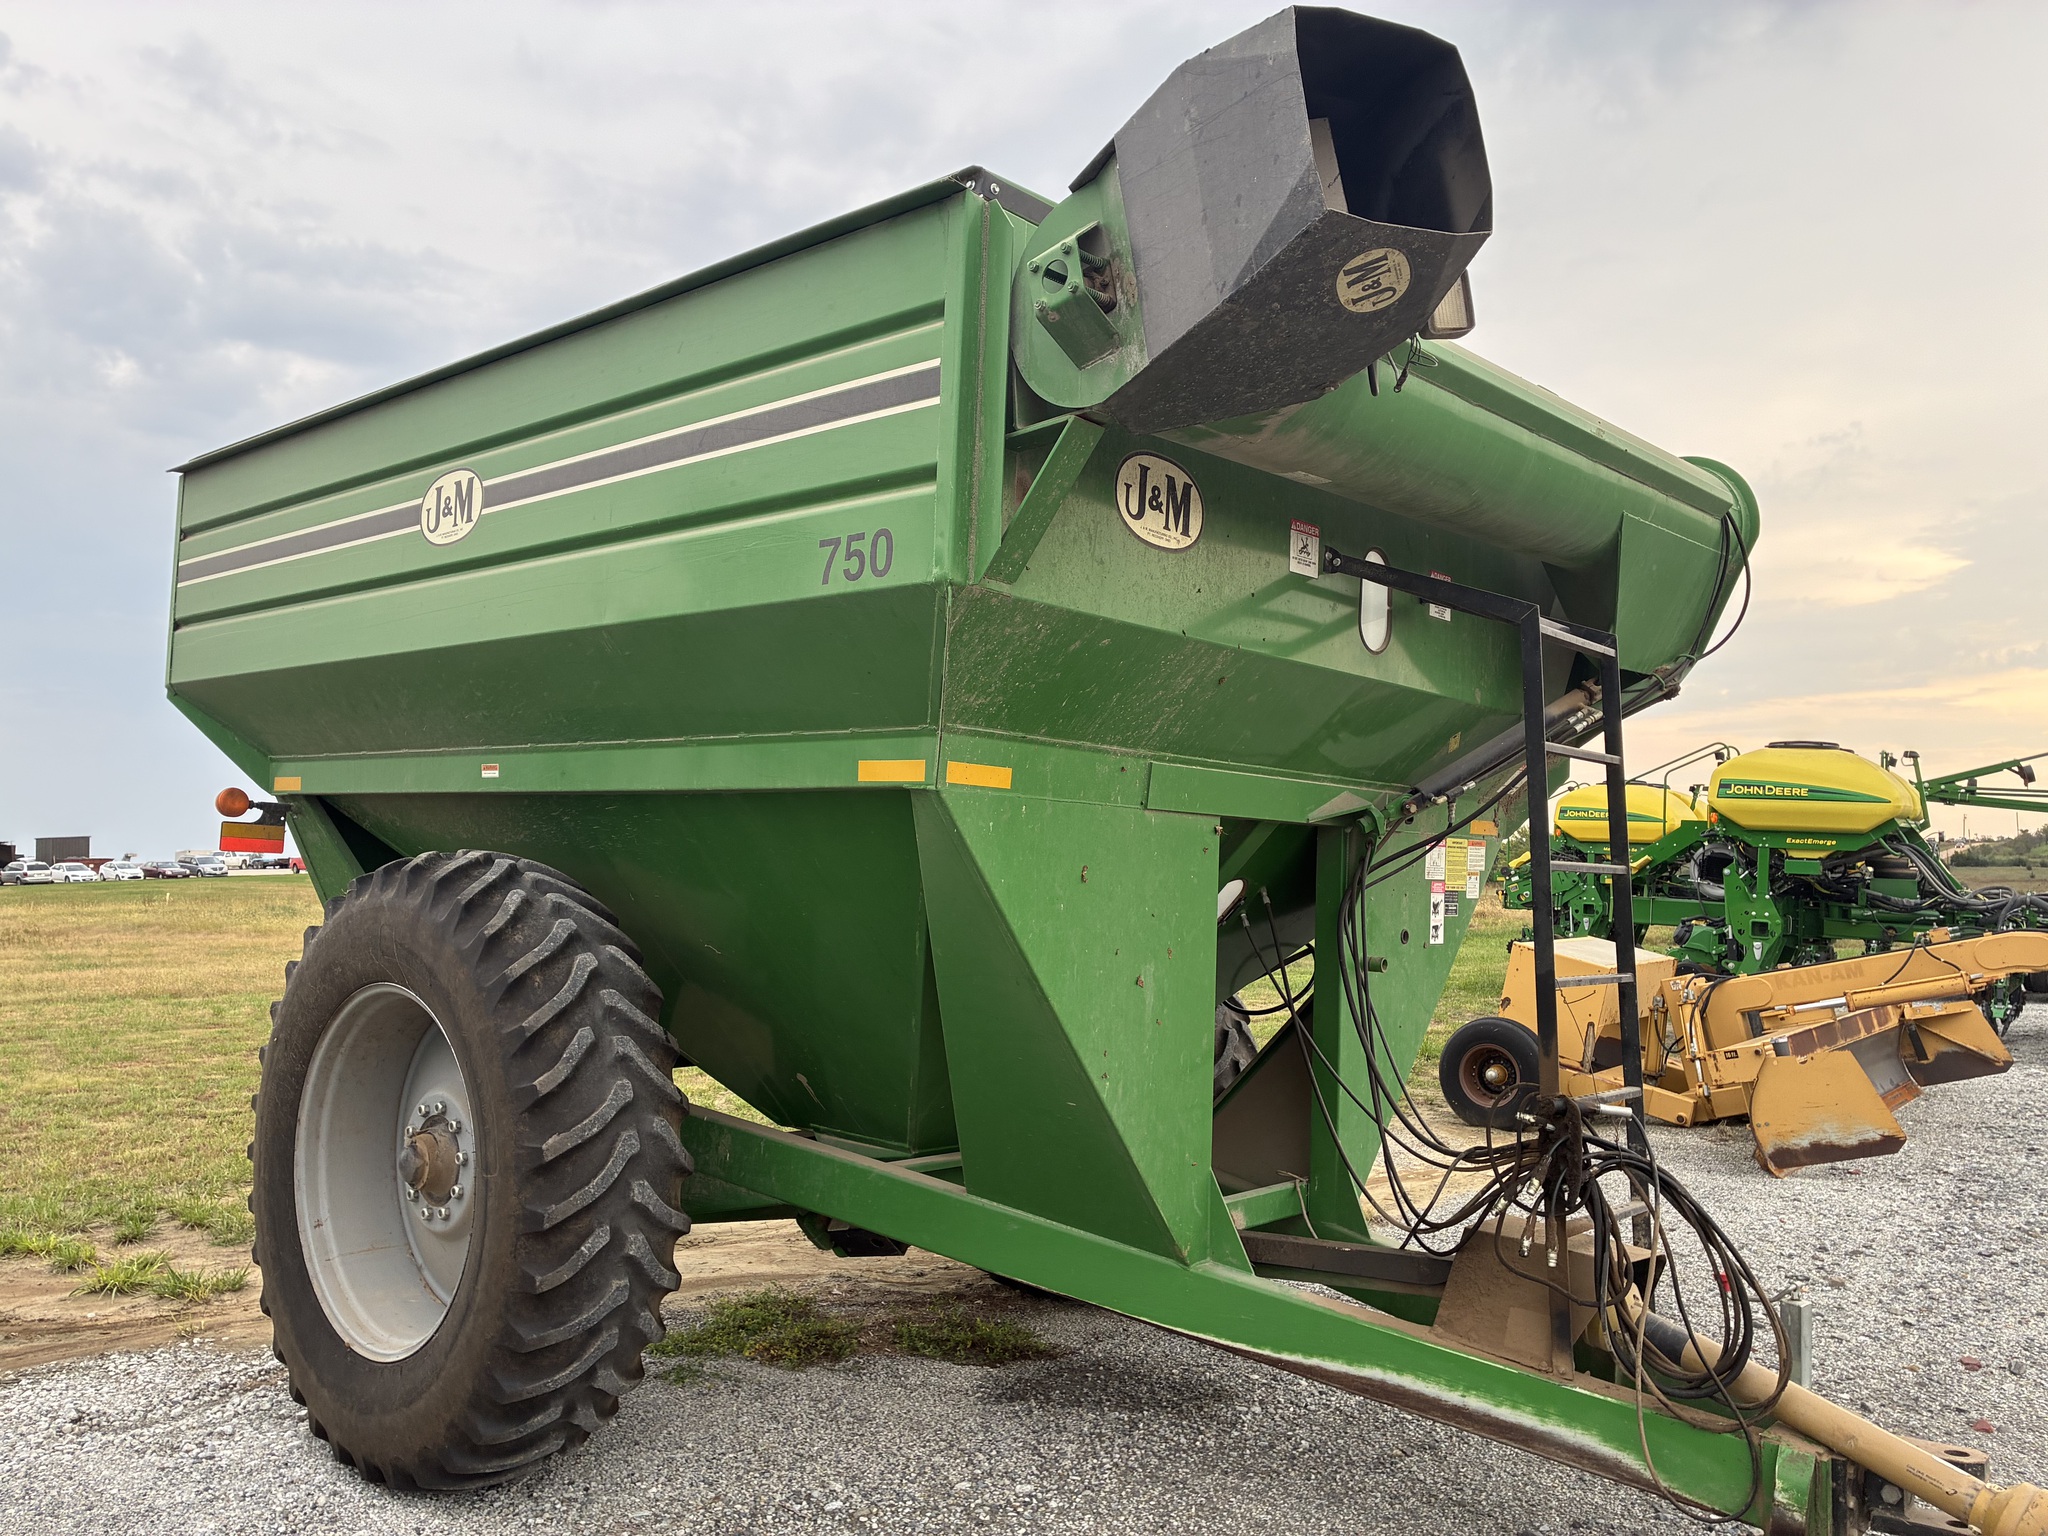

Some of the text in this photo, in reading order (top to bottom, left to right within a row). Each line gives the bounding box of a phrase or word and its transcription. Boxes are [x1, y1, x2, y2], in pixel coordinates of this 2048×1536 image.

[1342, 252, 1397, 307] J&M
[425, 476, 475, 533] J&M
[1123, 463, 1193, 538] J&M
[819, 528, 893, 585] 750
[1296, 522, 1319, 537] DANGER
[1765, 785, 1808, 797] DEERE
[1774, 962, 1864, 990] KAN-AM
